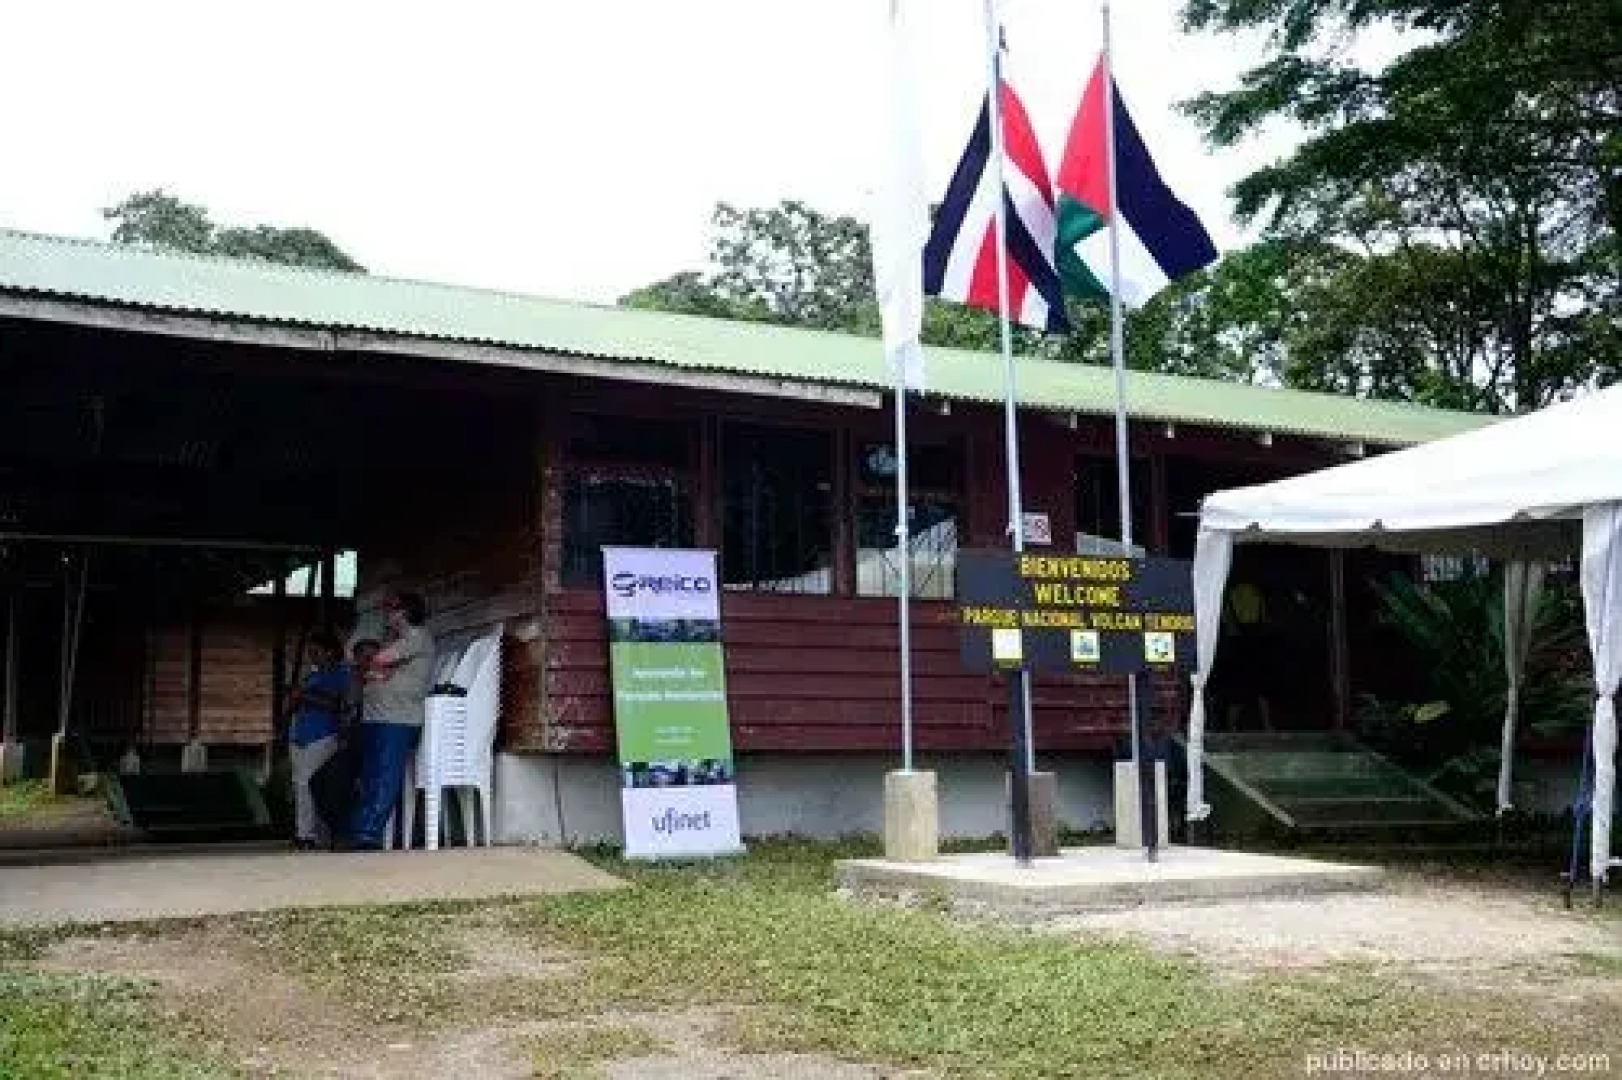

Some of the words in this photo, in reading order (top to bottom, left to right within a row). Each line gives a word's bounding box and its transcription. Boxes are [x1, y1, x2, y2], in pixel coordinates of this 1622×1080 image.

[1020, 556, 1131, 580] BIENVENIDOS
[1033, 583, 1121, 607] WELCOME
[963, 606, 1018, 628] PARQUE
[1022, 609, 1084, 628] NACIONAL
[651, 806, 711, 835] ufinet
